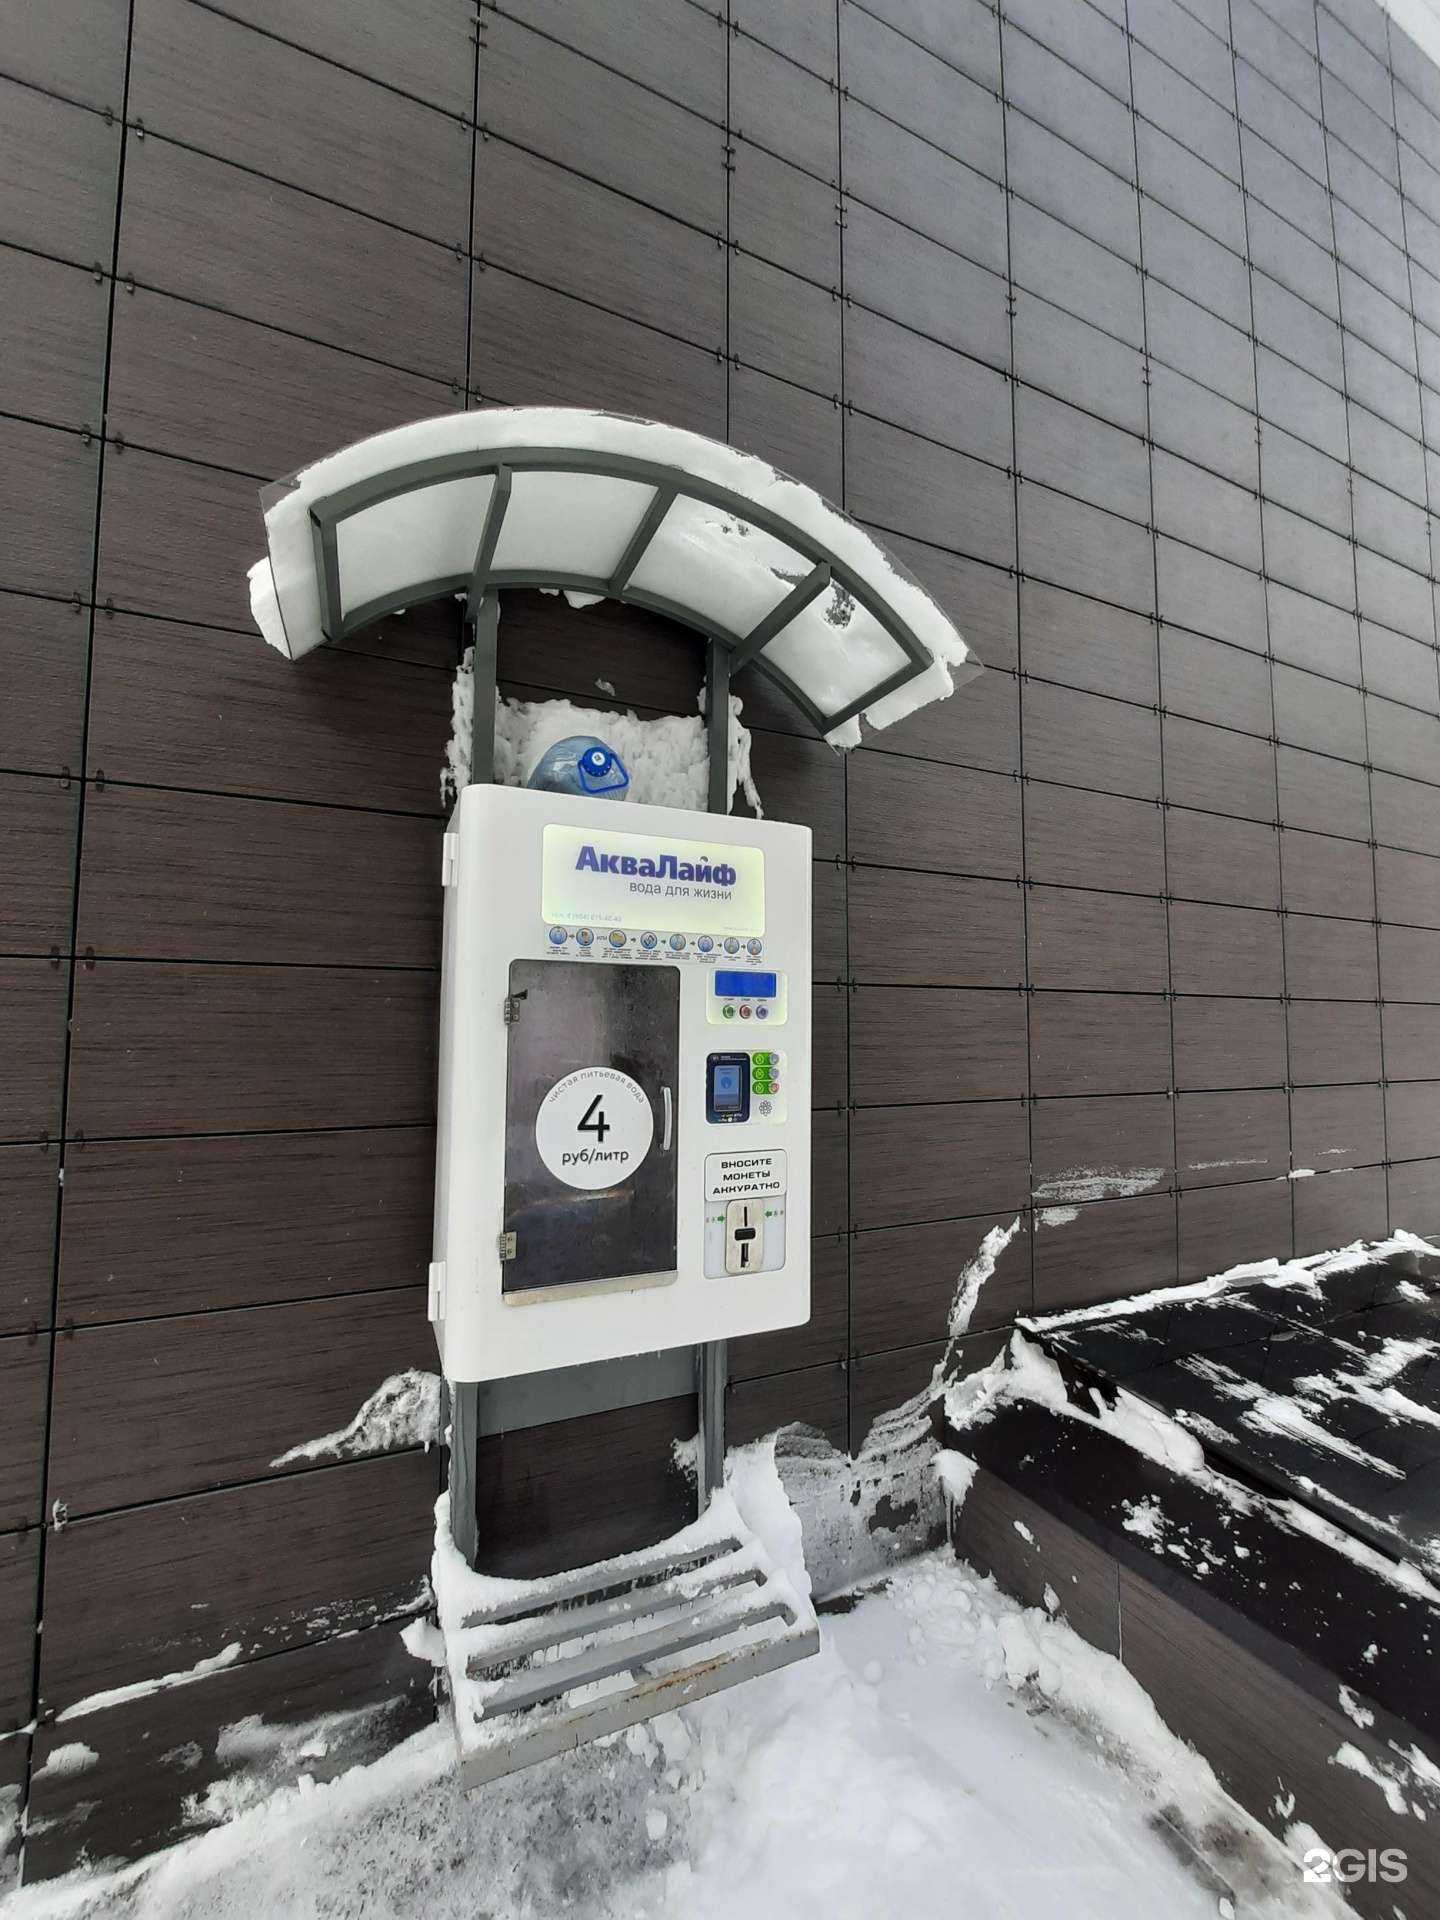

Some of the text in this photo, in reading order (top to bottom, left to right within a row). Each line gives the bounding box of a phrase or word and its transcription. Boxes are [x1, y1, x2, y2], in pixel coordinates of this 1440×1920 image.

[575, 846, 737, 887] АкваЛайф
[629, 882, 732, 900] вода для жизни
[580, 1070, 626, 1083] питьевая
[626, 1082, 645, 1103] вода
[577, 1094, 611, 1142] 4
[562, 1148, 629, 1165] руб/литр
[721, 1158, 772, 1169] ВНОСИТЕ
[723, 1170, 771, 1181] МОНЕТЫ
[712, 1181, 780, 1195] АККУРАТНО
